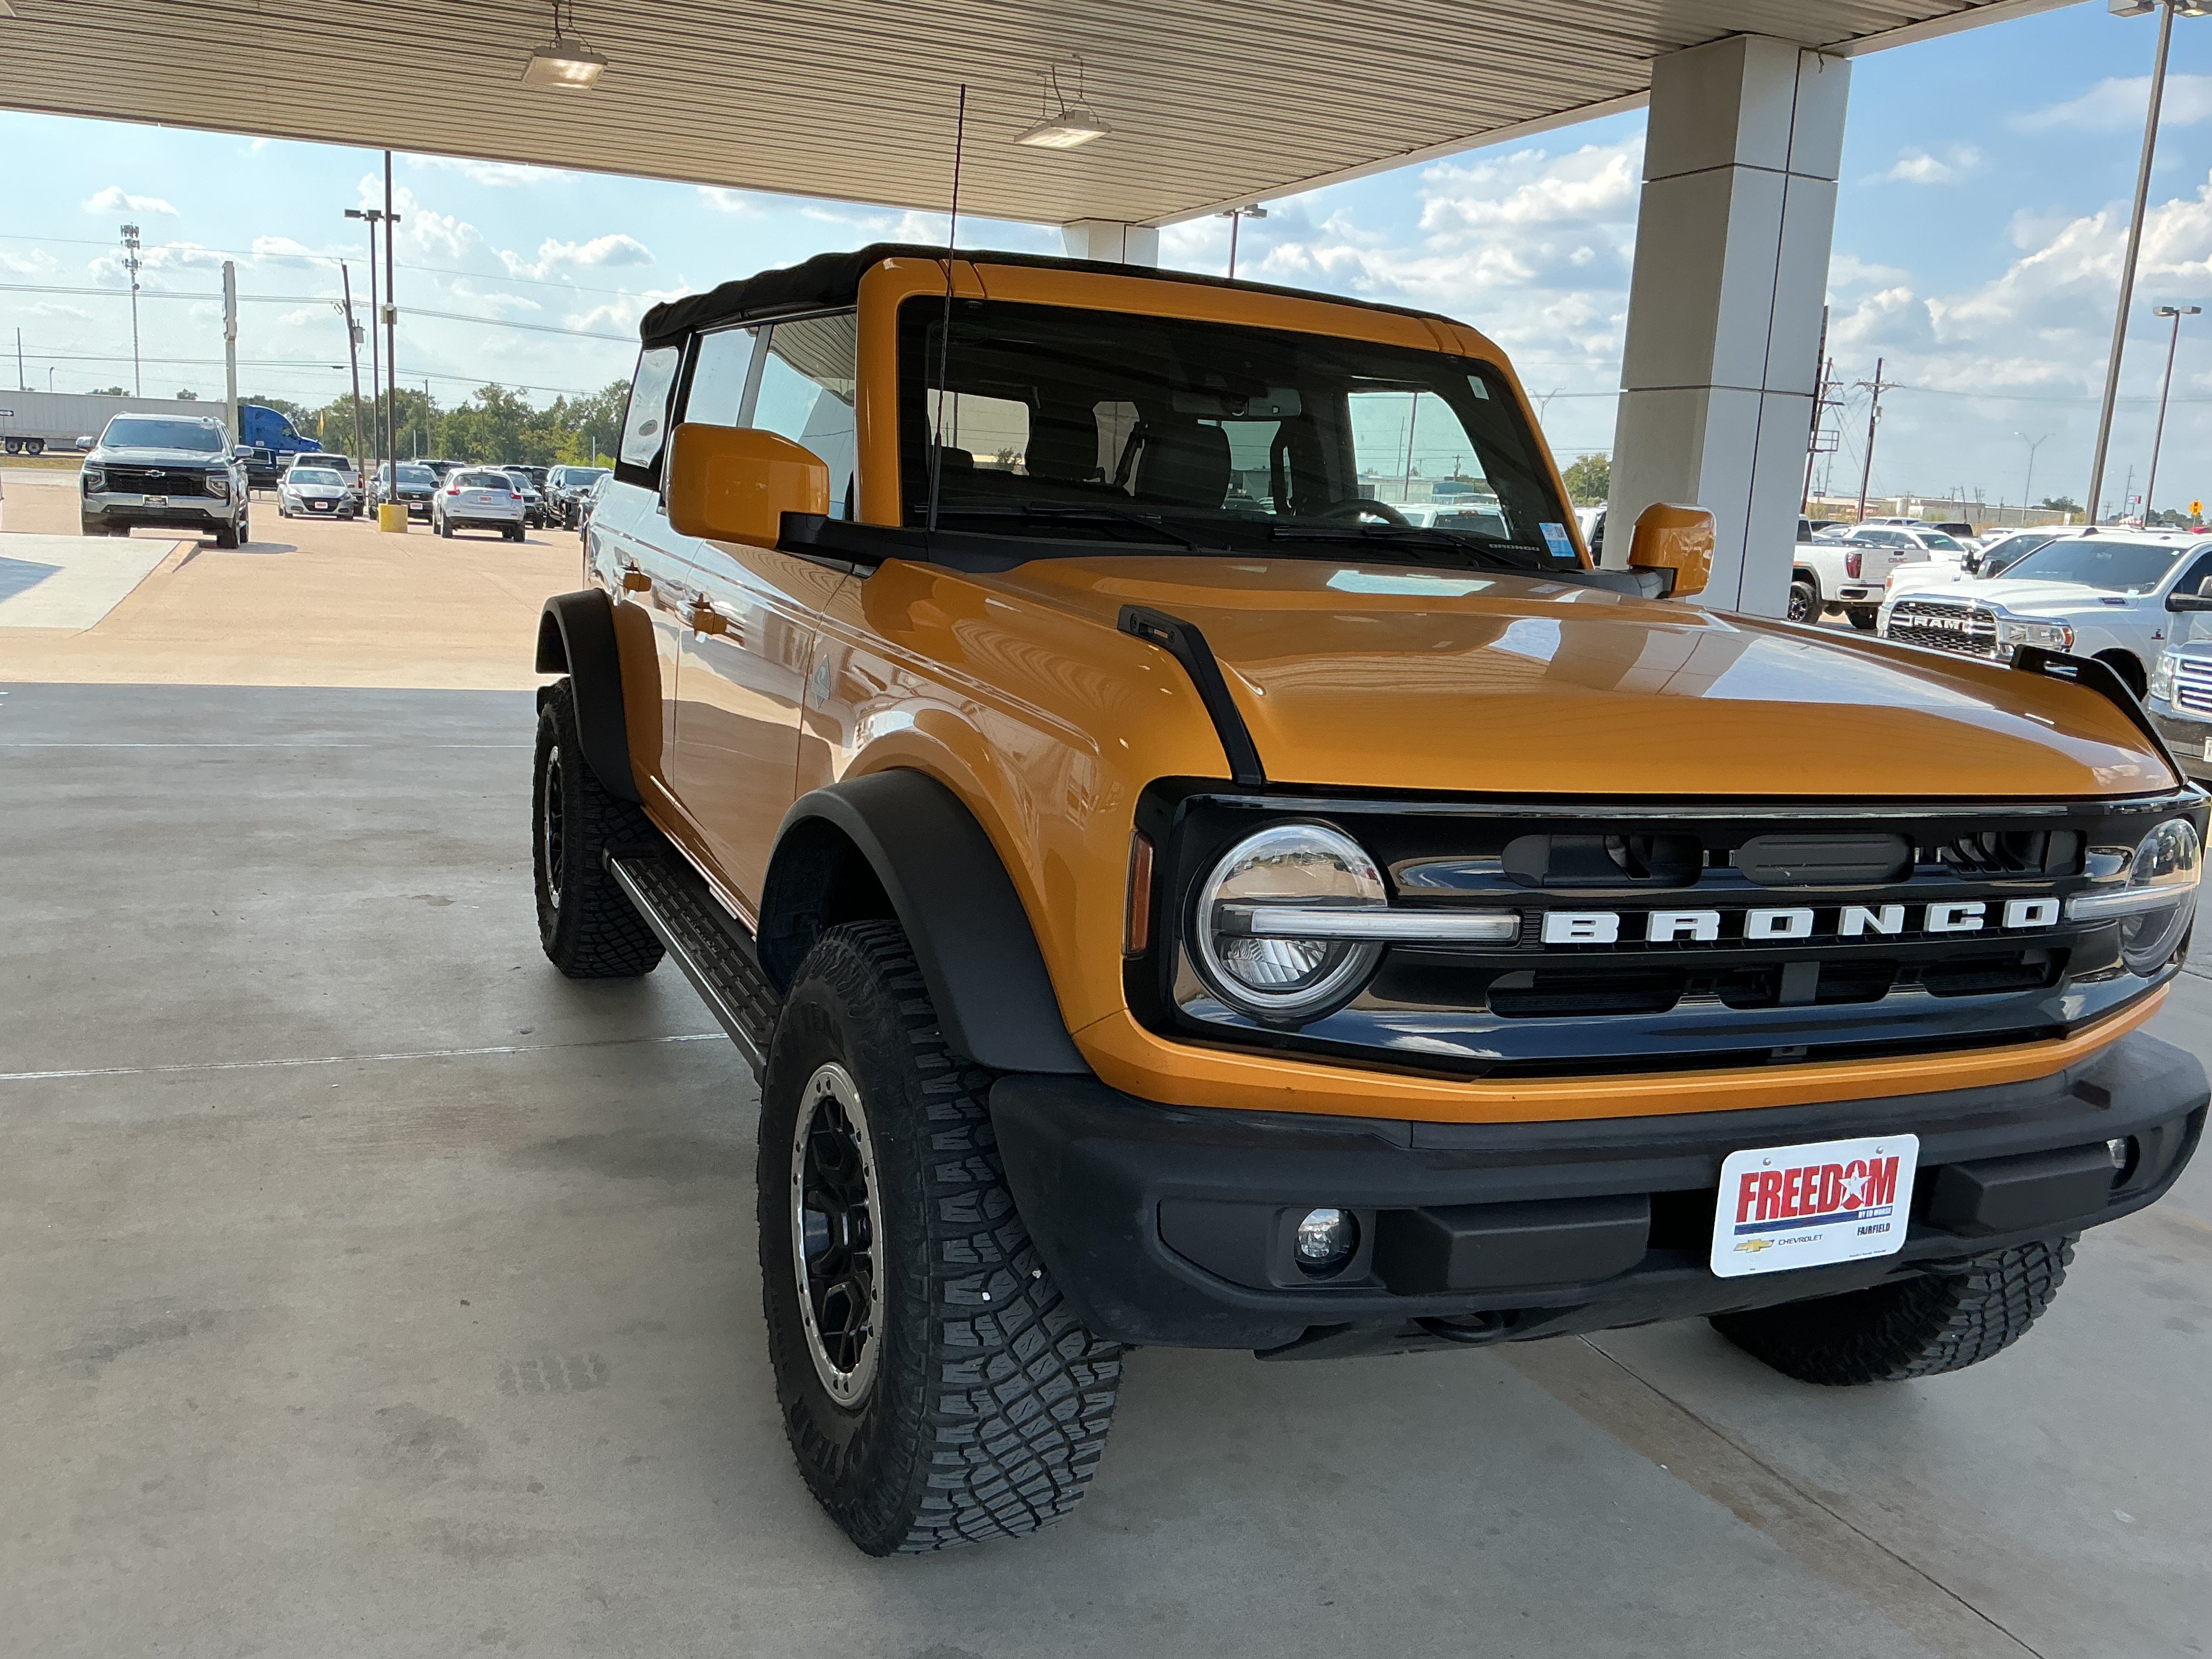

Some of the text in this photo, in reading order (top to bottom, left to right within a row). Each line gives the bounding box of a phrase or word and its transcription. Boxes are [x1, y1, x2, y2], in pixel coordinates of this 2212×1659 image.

[1489, 543, 1540, 551] BRONCO
[1914, 618, 1960, 630] RAM
[1541, 898, 2060, 943] BRONCO
[1735, 1156, 1900, 1223] FREEDOM
[1858, 1223, 1891, 1236] FAIRFIELD
[1779, 1234, 1824, 1246] CHEVROLET
